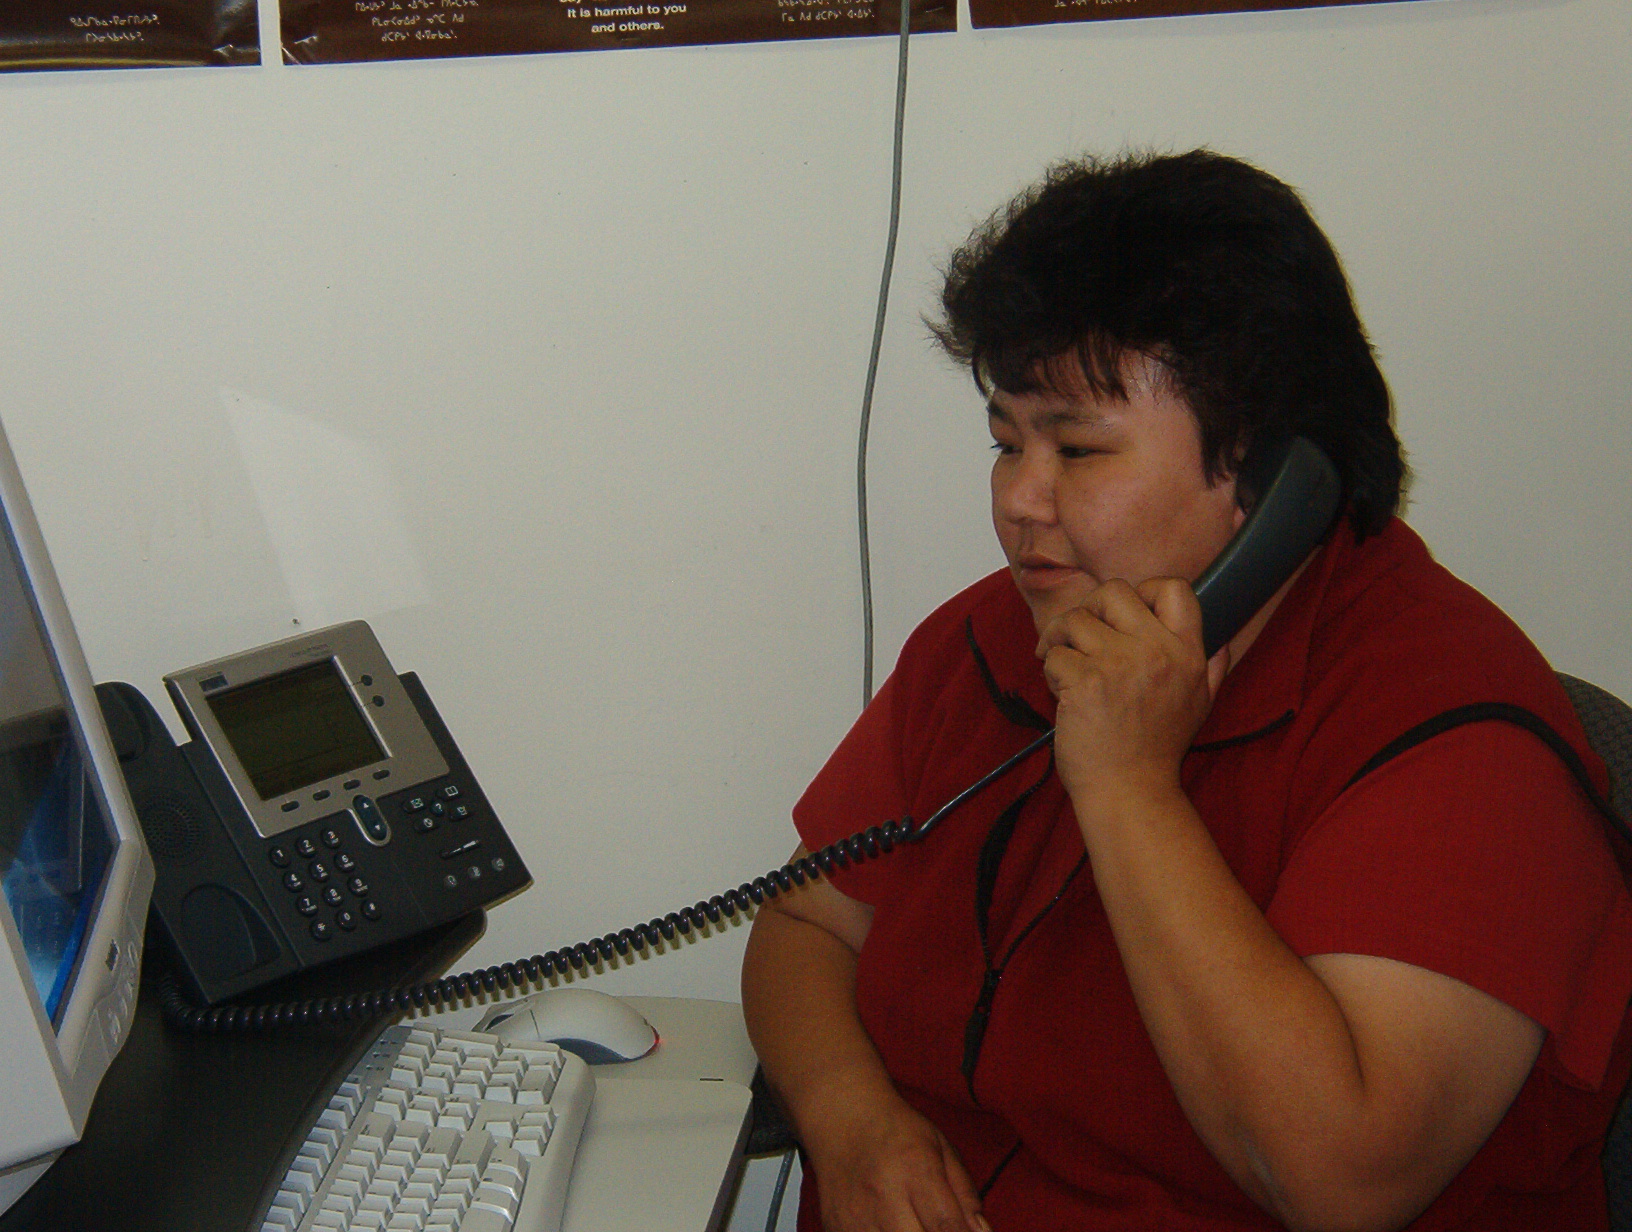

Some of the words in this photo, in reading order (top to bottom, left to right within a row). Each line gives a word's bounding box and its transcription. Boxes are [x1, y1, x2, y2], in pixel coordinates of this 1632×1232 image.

[567, 8, 577, 19] It
[580, 7, 591, 18] is
[594, 5, 644, 17] harmful
[647, 4, 660, 14] to
[663, 4, 687, 16] you
[591, 22, 615, 33] and
[618, 20, 665, 32] others.
